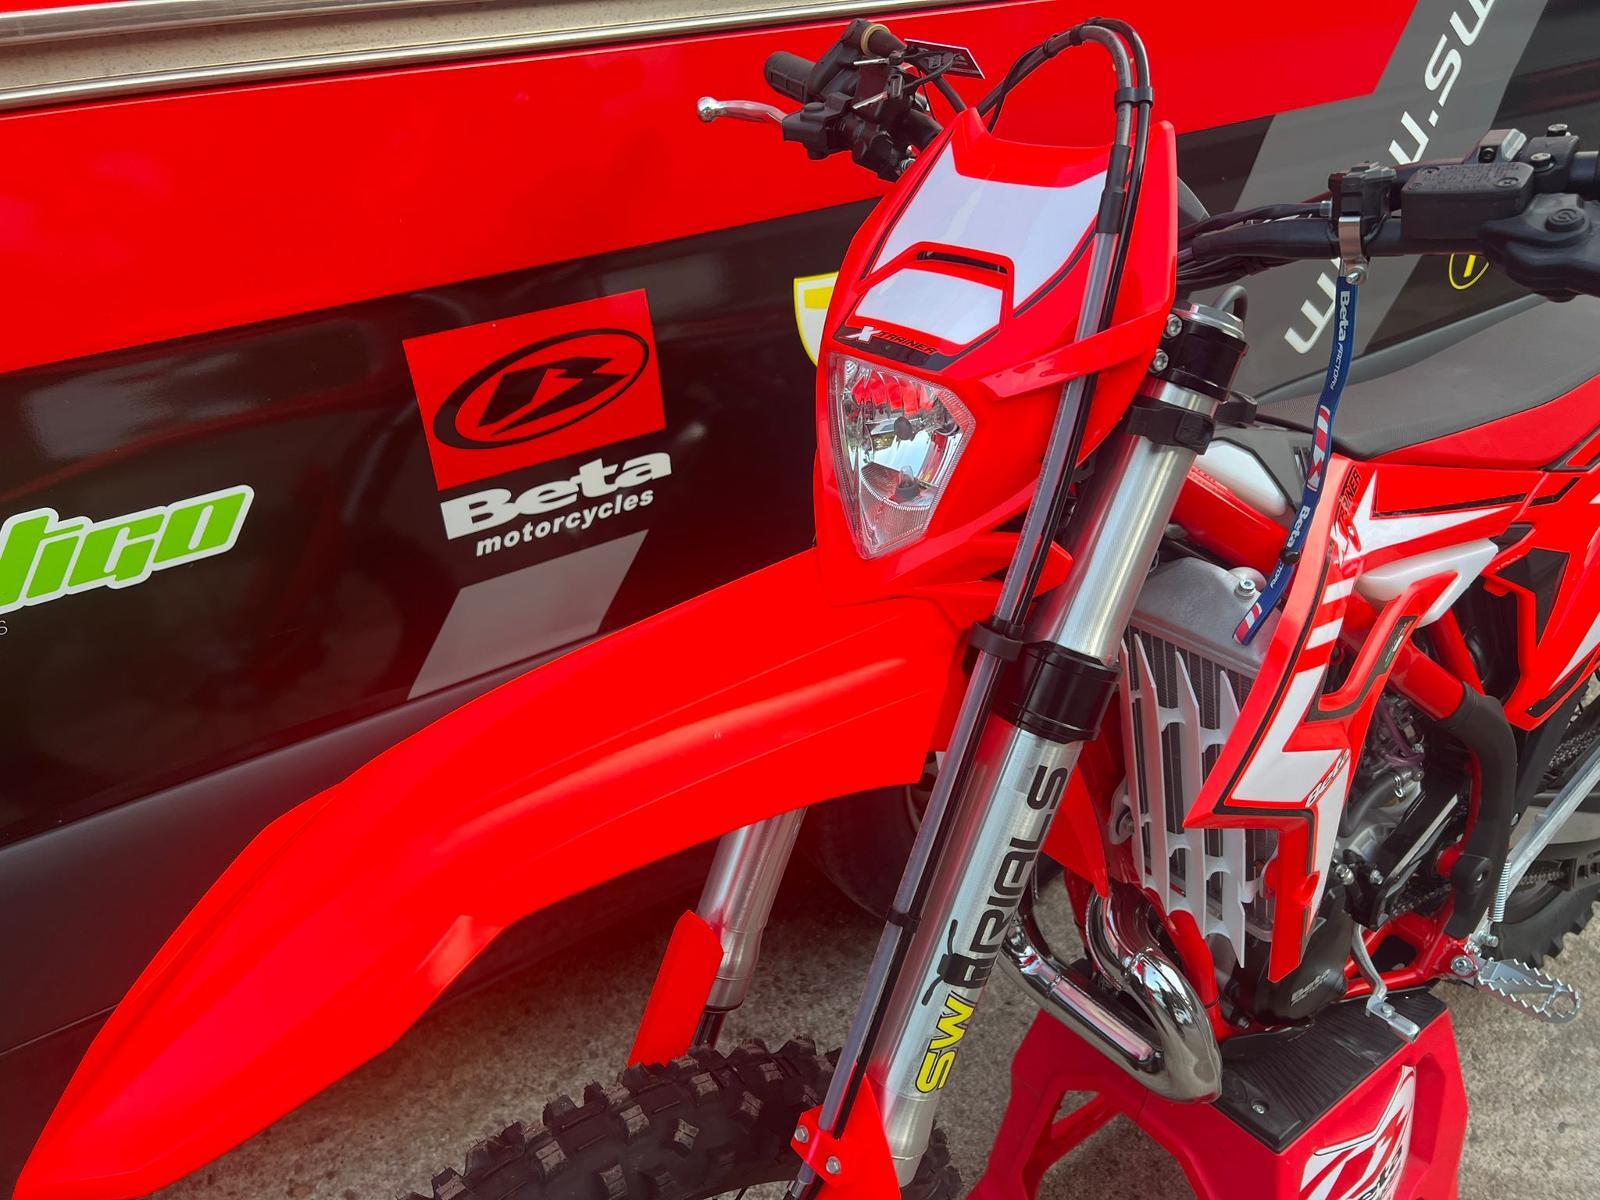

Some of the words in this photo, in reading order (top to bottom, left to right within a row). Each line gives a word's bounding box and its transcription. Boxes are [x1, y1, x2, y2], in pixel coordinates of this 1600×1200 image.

[1338, 290, 1351, 342] Beta
[440, 452, 672, 540] Beta
[475, 489, 654, 557] motorcycles
[1286, 505, 1310, 548] Beta
[914, 990, 978, 1094] SW
